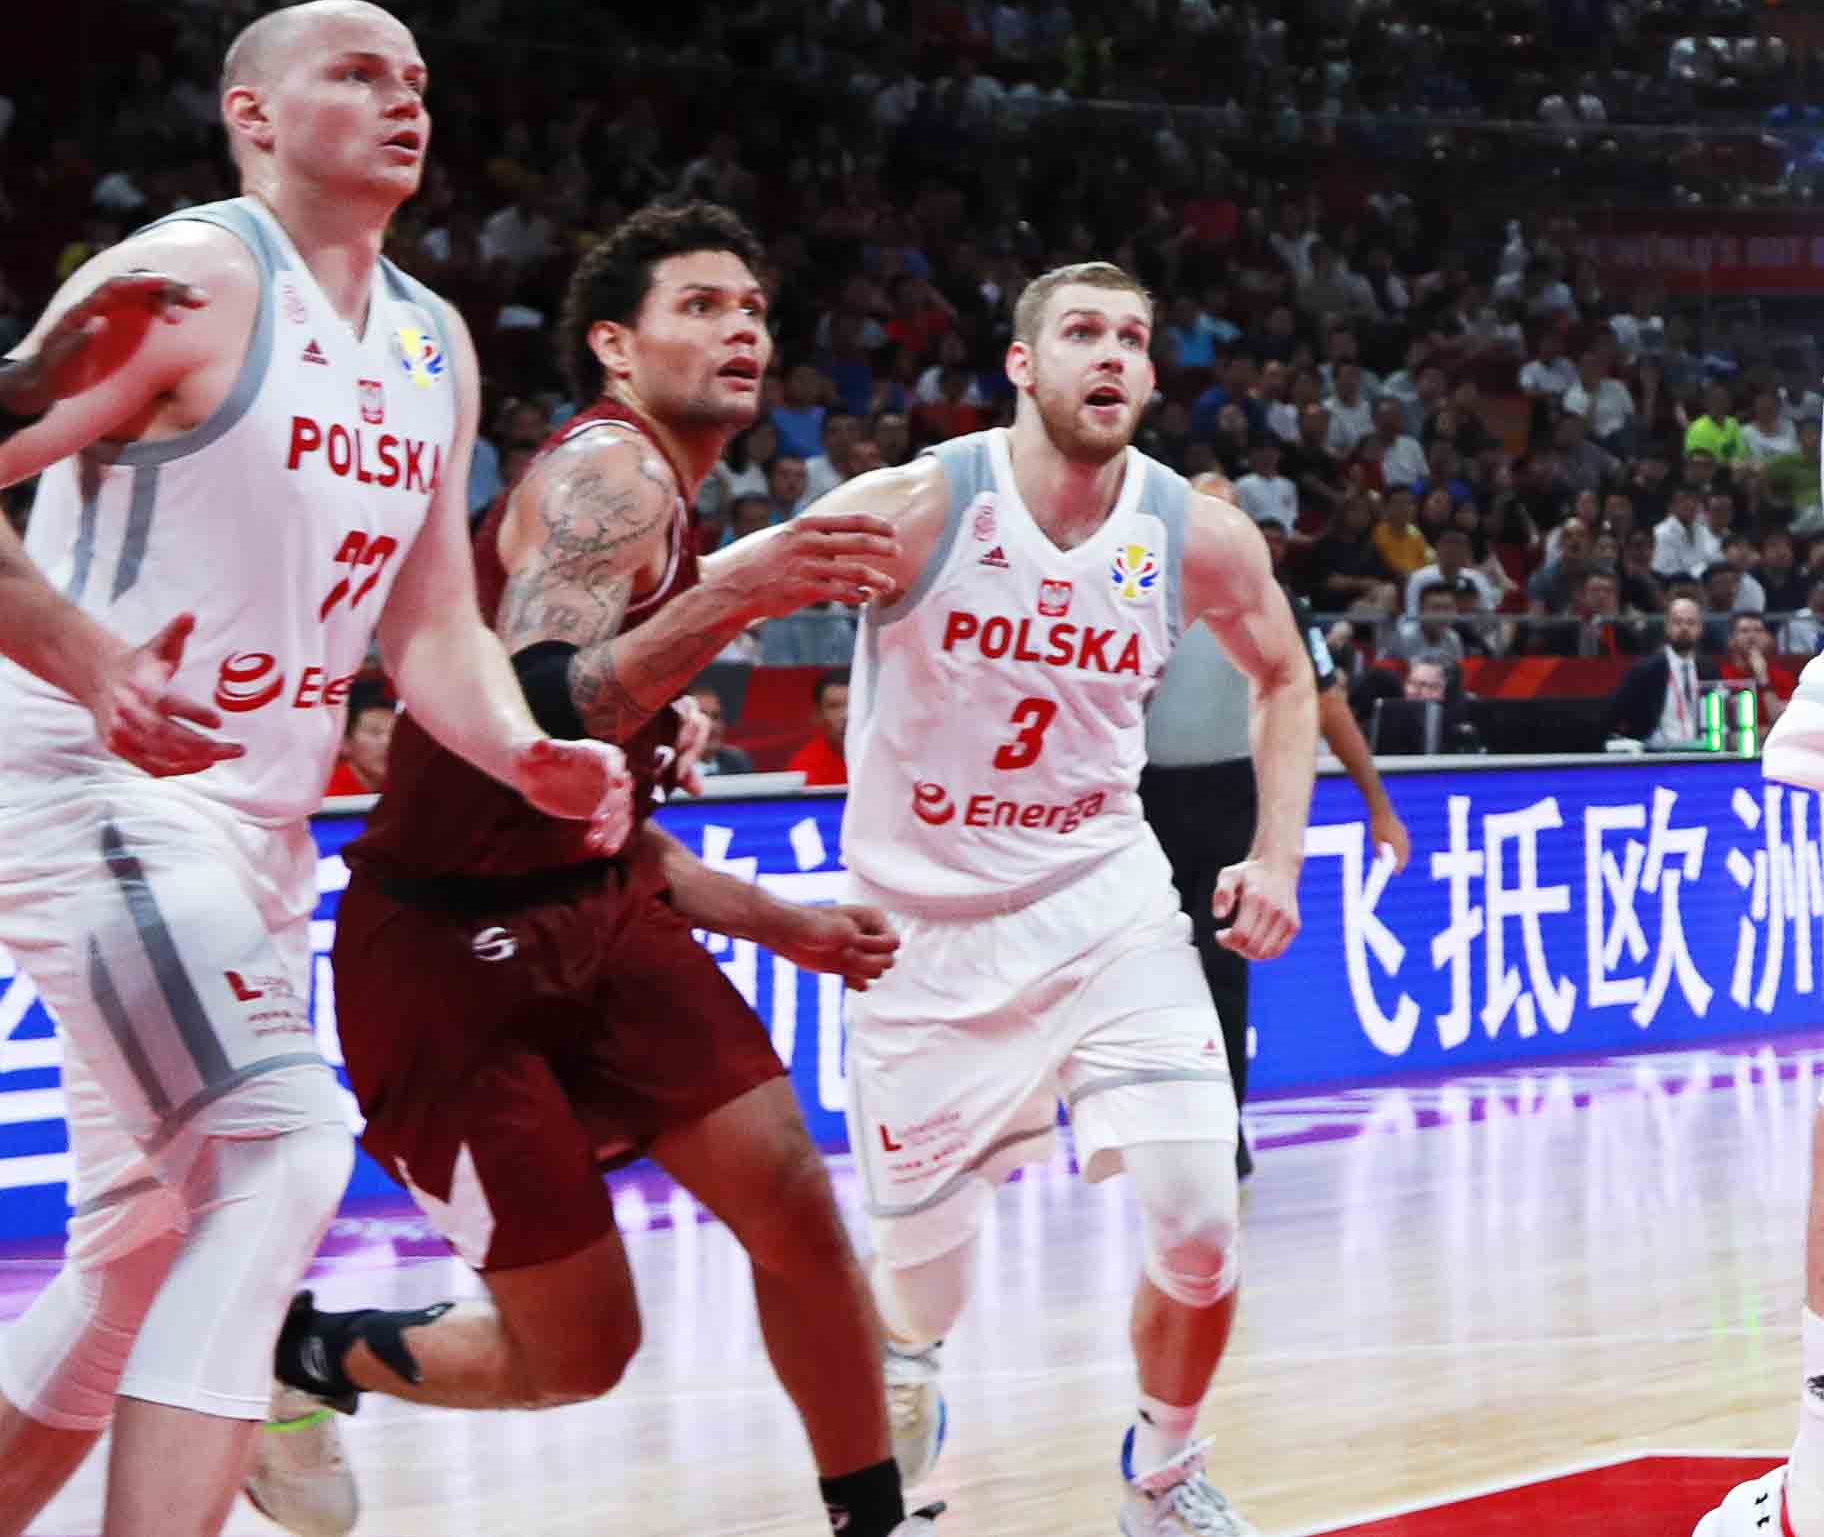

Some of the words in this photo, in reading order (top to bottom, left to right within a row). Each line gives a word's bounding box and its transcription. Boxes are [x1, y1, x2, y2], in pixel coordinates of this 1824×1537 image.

[942, 612, 1143, 676] POLSKA
[993, 698, 1057, 769] 3
[964, 790, 1106, 835] Energa
